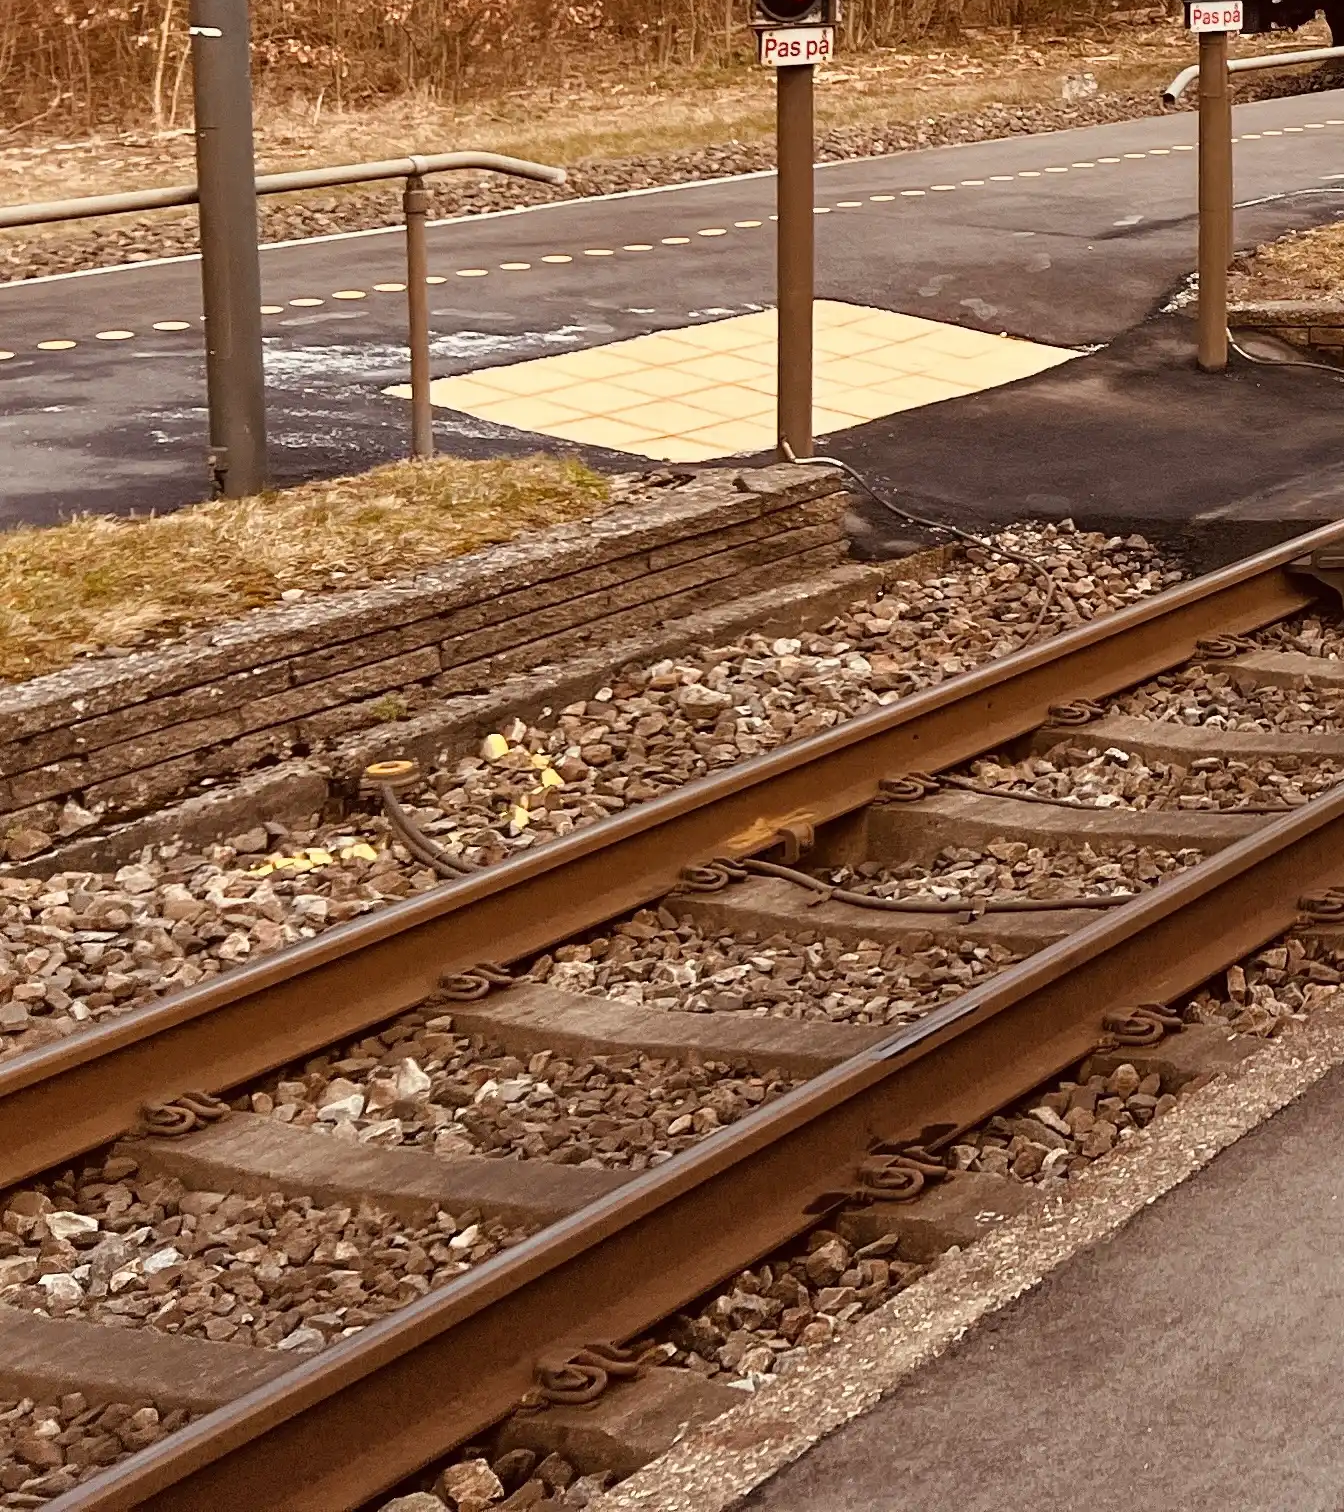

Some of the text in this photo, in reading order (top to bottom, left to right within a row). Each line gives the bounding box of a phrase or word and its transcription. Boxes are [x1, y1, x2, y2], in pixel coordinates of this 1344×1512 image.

[1193, 4, 1241, 27] Pas på
[764, 33, 829, 60] Pas på
